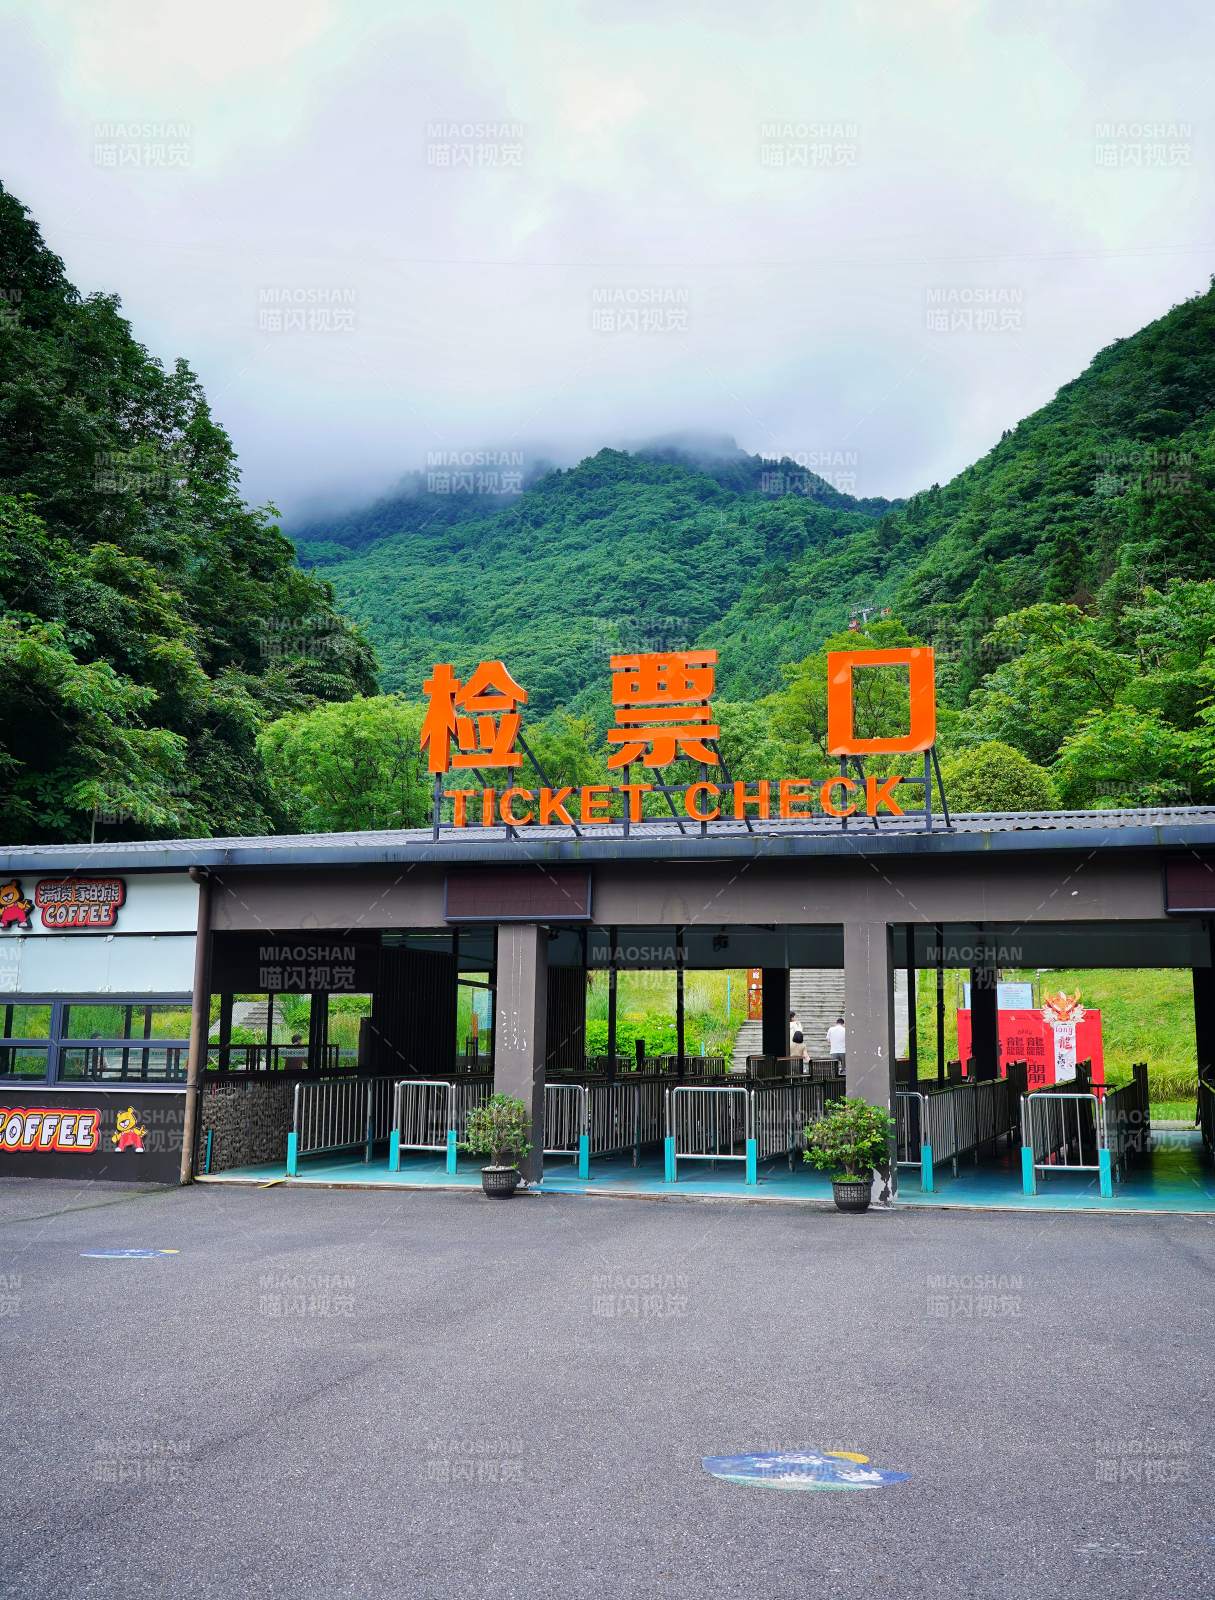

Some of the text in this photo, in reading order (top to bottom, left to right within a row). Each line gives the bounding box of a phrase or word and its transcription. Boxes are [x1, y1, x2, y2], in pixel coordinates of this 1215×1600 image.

[444, 783, 653, 828] TICKET
[685, 775, 904, 823] CHECK
[45, 904, 111, 924] COFFEE
[0, 1113, 93, 1147] OFFEE
